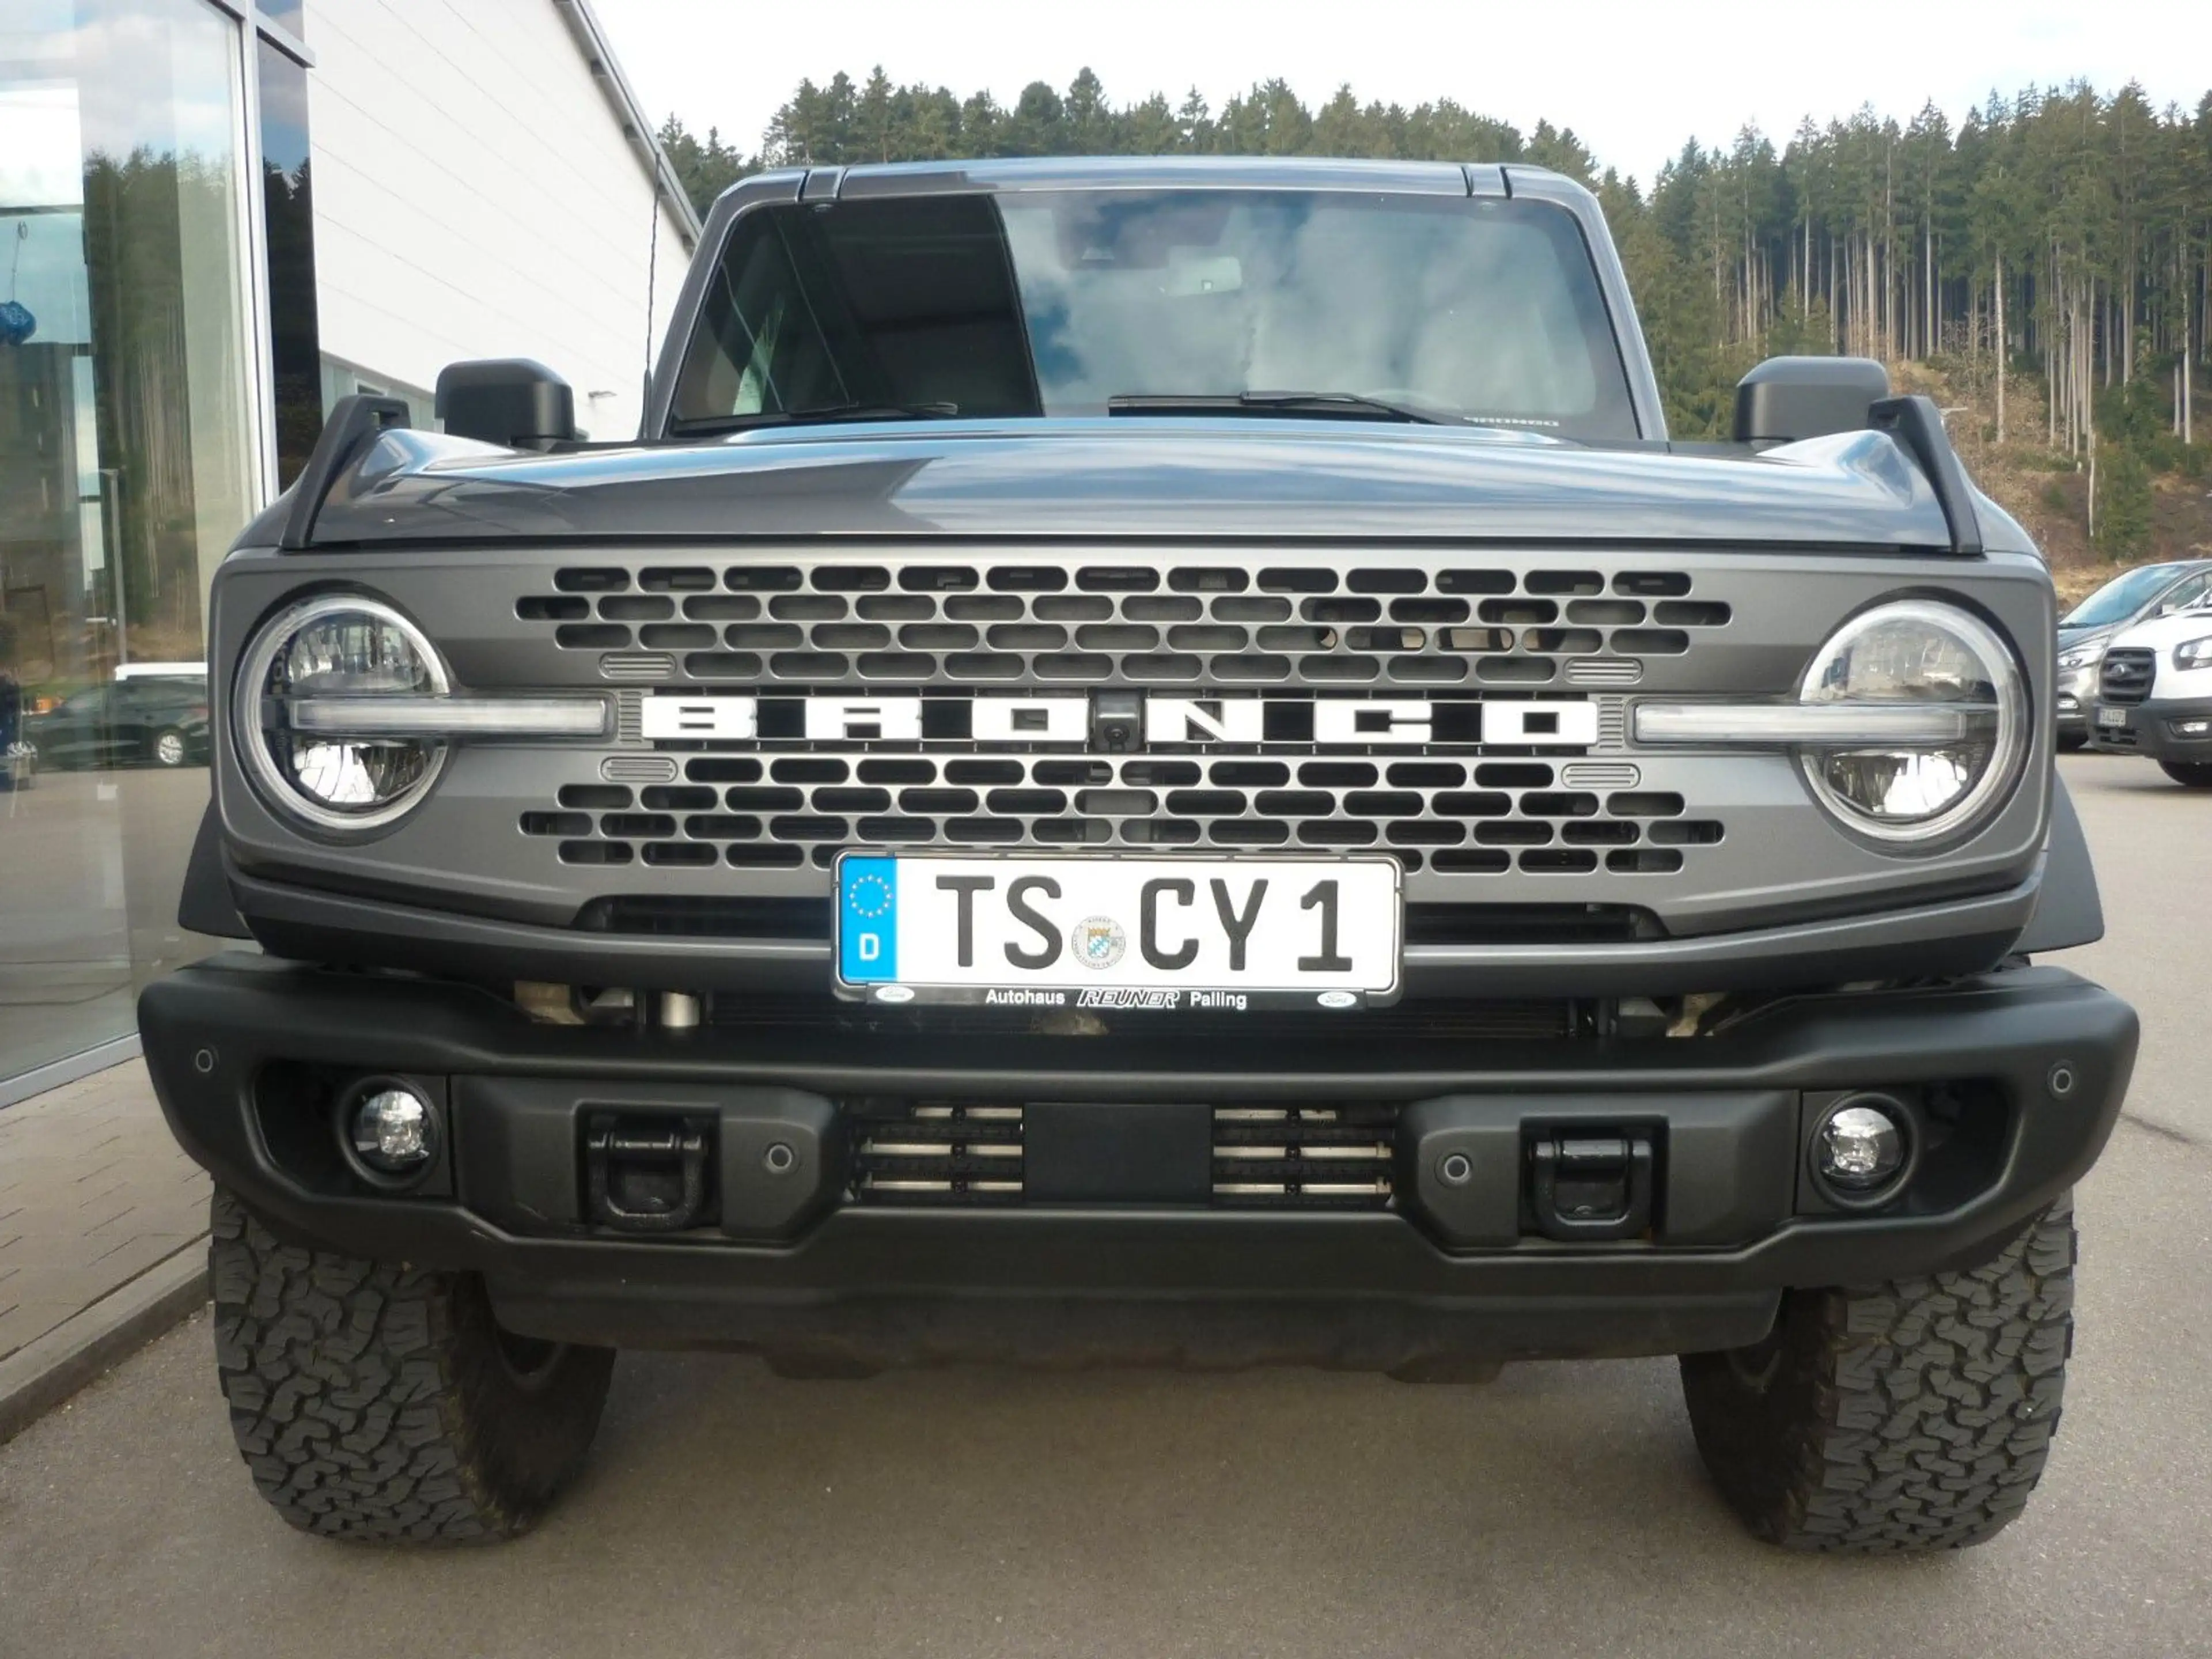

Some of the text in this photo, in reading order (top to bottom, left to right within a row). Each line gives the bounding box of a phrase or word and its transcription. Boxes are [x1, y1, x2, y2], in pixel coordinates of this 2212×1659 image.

[642, 697, 1598, 744] BRONCO
[935, 875, 1063, 970] TS
[1140, 877, 1269, 972] CY
[1297, 880, 1353, 972] 1
[859, 933, 880, 961] D
[986, 987, 1248, 1010] Autohaus REUNER Palling
